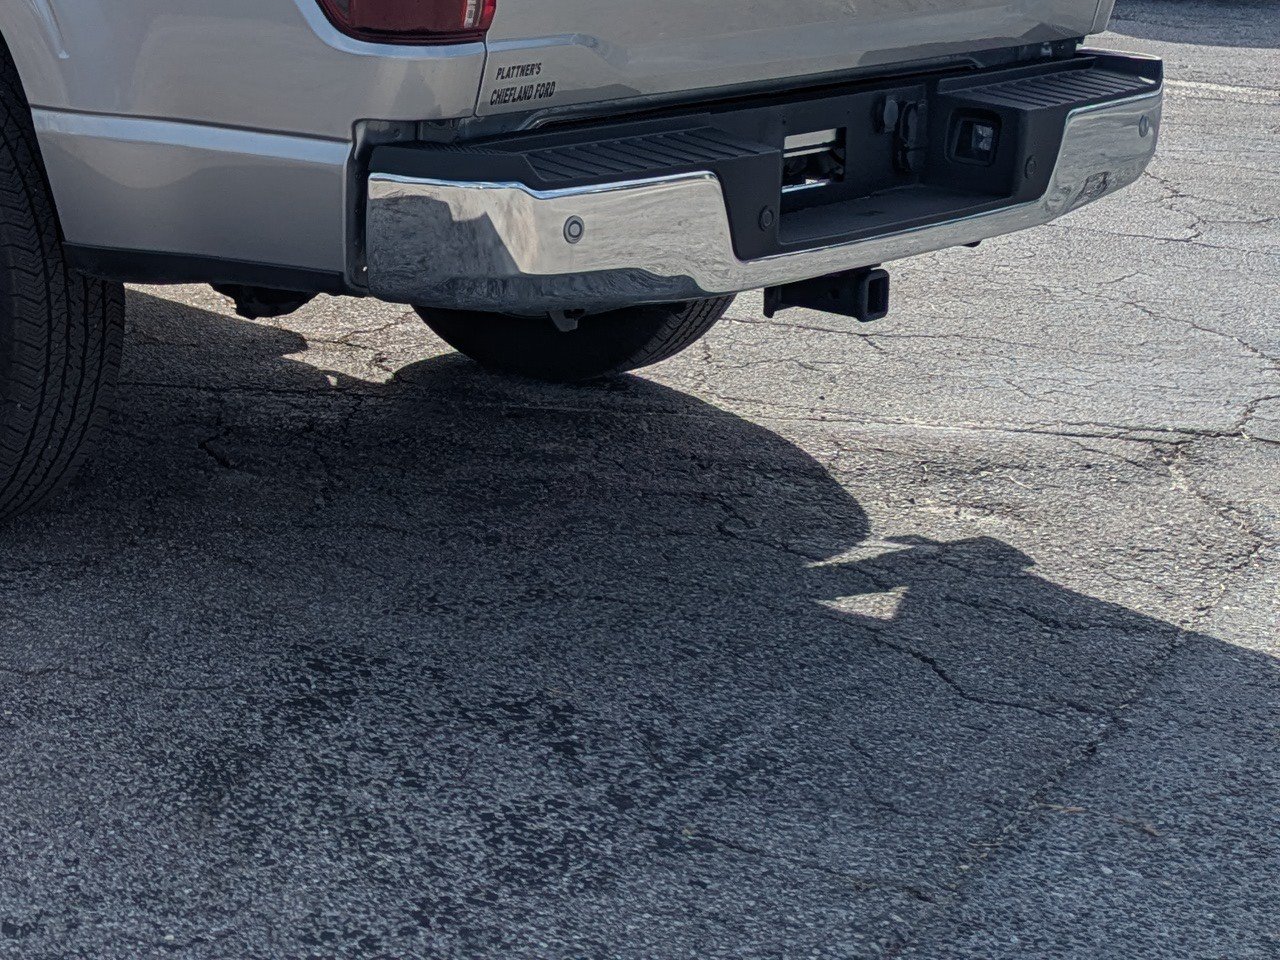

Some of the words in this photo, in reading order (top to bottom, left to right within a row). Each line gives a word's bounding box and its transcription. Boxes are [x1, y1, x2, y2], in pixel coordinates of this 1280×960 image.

[496, 63, 541, 79] PLATTNER'S
[490, 85, 534, 105] CHIEFLAND
[534, 81, 556, 99] FORD
